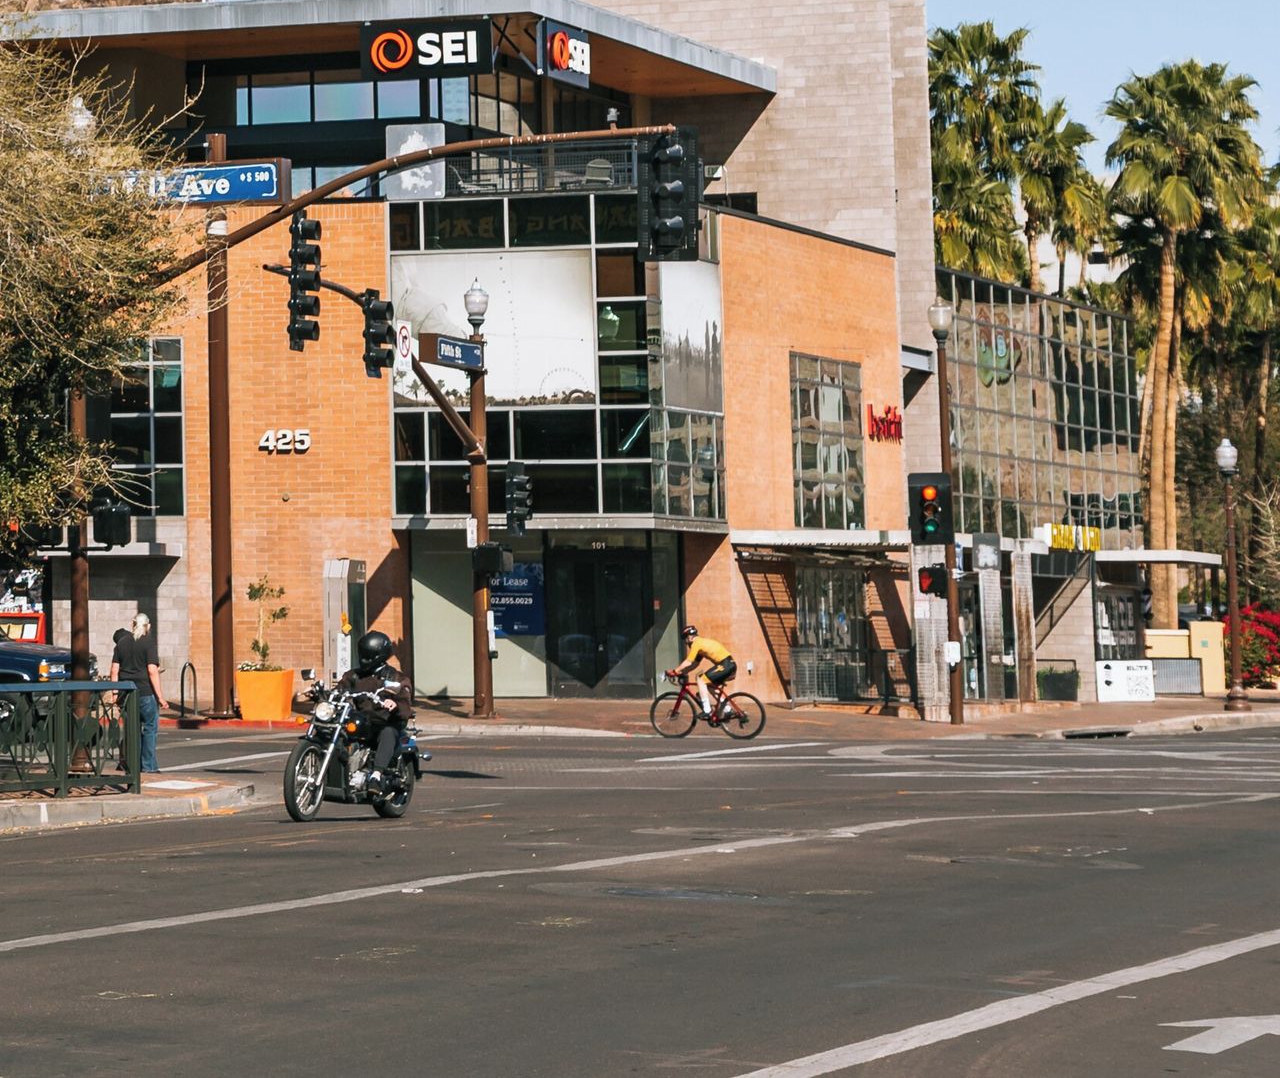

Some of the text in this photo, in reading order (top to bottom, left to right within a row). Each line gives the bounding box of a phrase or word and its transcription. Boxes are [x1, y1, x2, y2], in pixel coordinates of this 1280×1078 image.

[417, 30, 478, 66] SEI
[568, 38, 591, 75] SEI
[179, 174, 230, 196] Ave
[254, 171, 270, 182] 500
[258, 428, 311, 454] 425
[591, 541, 606, 550] 101
[490, 576, 529, 587] or Lease
[490, 596, 533, 606] 02.855.0029
